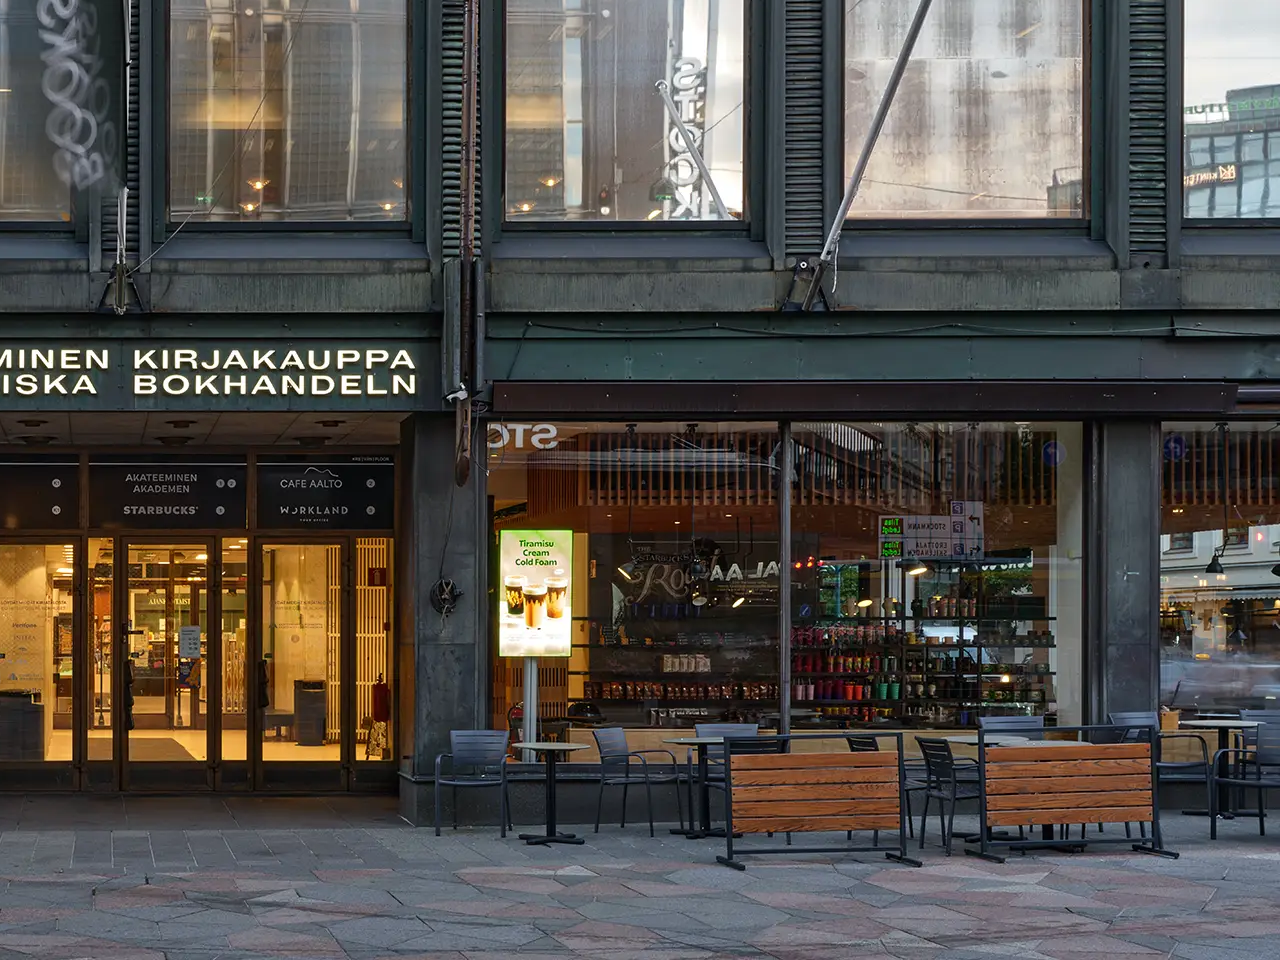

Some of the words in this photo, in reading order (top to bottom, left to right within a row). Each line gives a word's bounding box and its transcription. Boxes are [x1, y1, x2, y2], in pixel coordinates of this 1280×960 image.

[134, 349, 416, 370] KIRJAKAUPPA
[134, 374, 416, 395] BOKHANDELN
[125, 473, 198, 482] AKATEEMINEN
[280, 479, 307, 488] CAFE
[309, 479, 343, 488] AALTO
[133, 485, 190, 493] AKADEMEN
[515, 558, 534, 566] Cold
[535, 558, 558, 566] Foam
